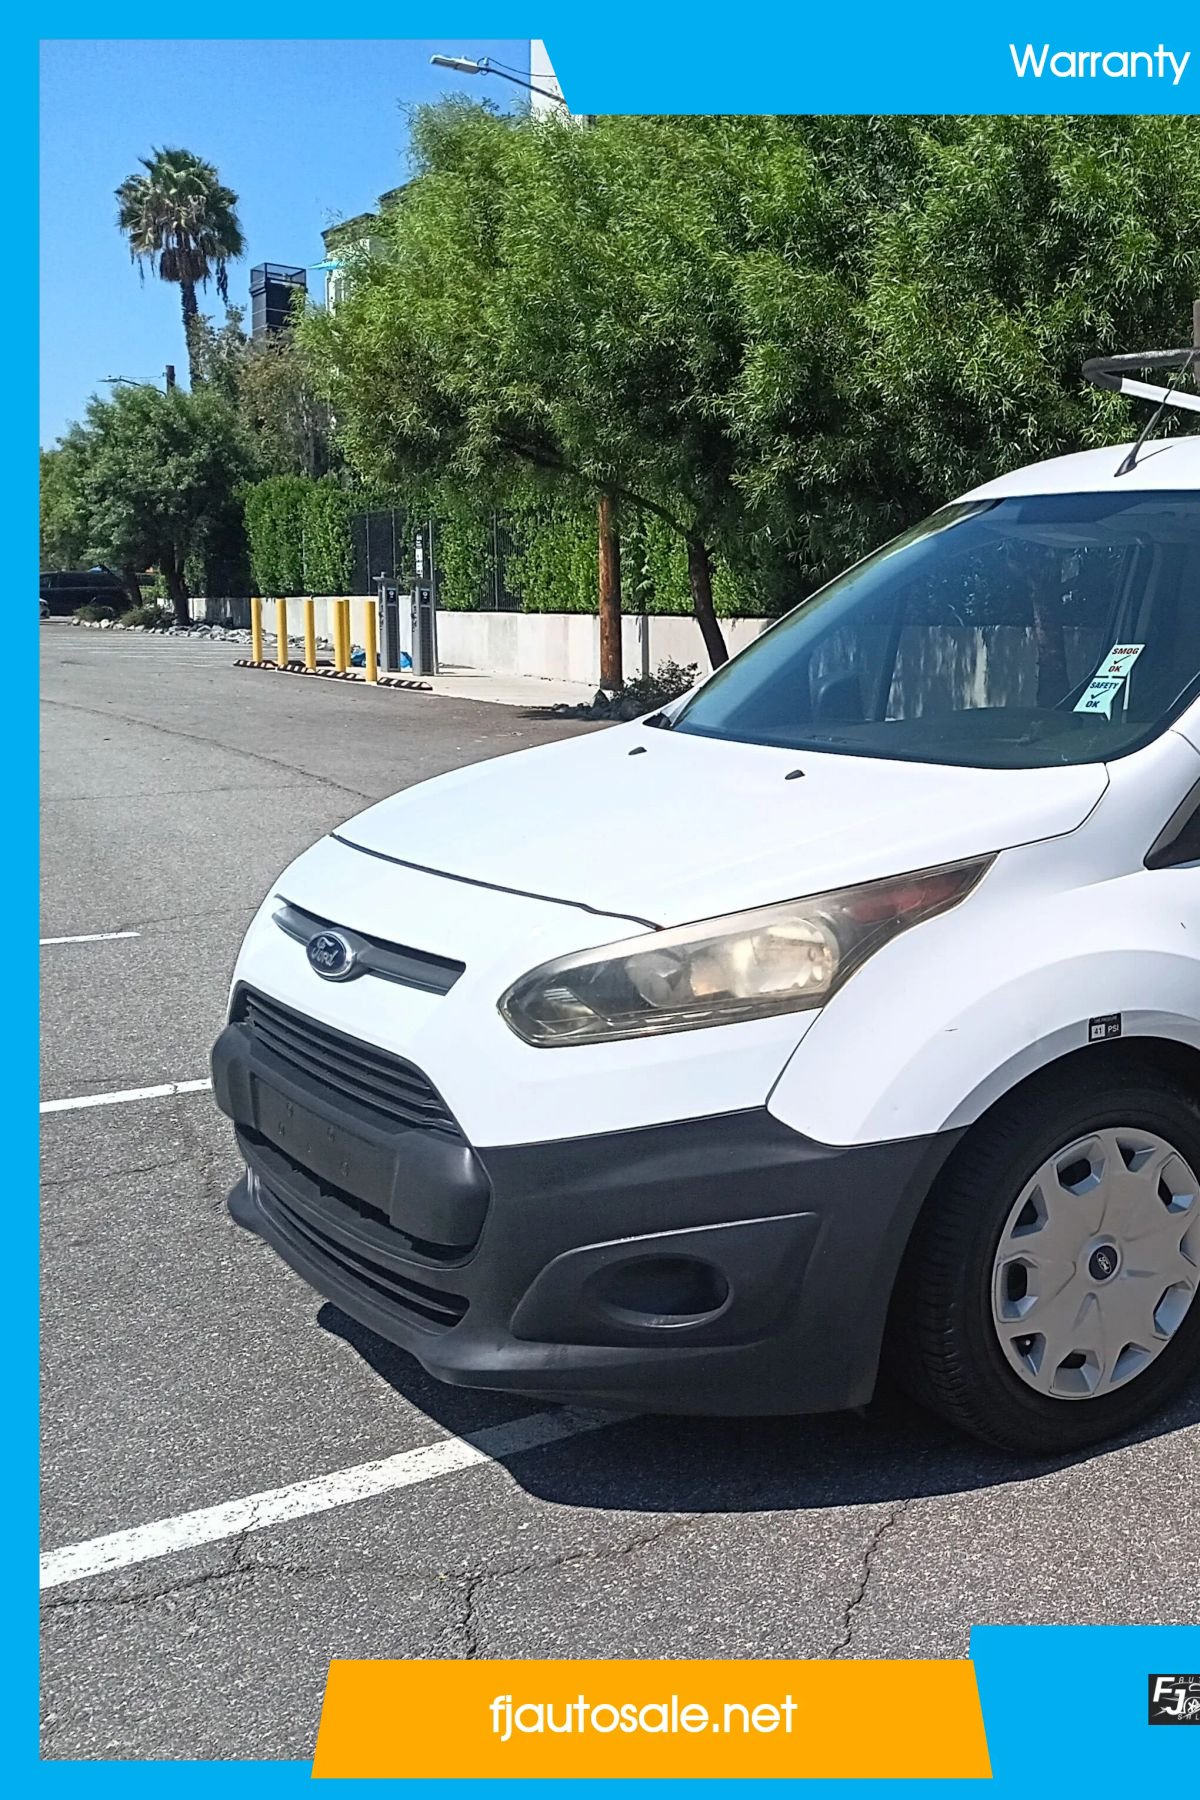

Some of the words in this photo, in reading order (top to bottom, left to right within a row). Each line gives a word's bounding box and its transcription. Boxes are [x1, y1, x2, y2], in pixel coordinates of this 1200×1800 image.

[1112, 647, 1139, 655] SMOG
[1085, 700, 1100, 708] OK
[312, 936, 339, 967] Ford
